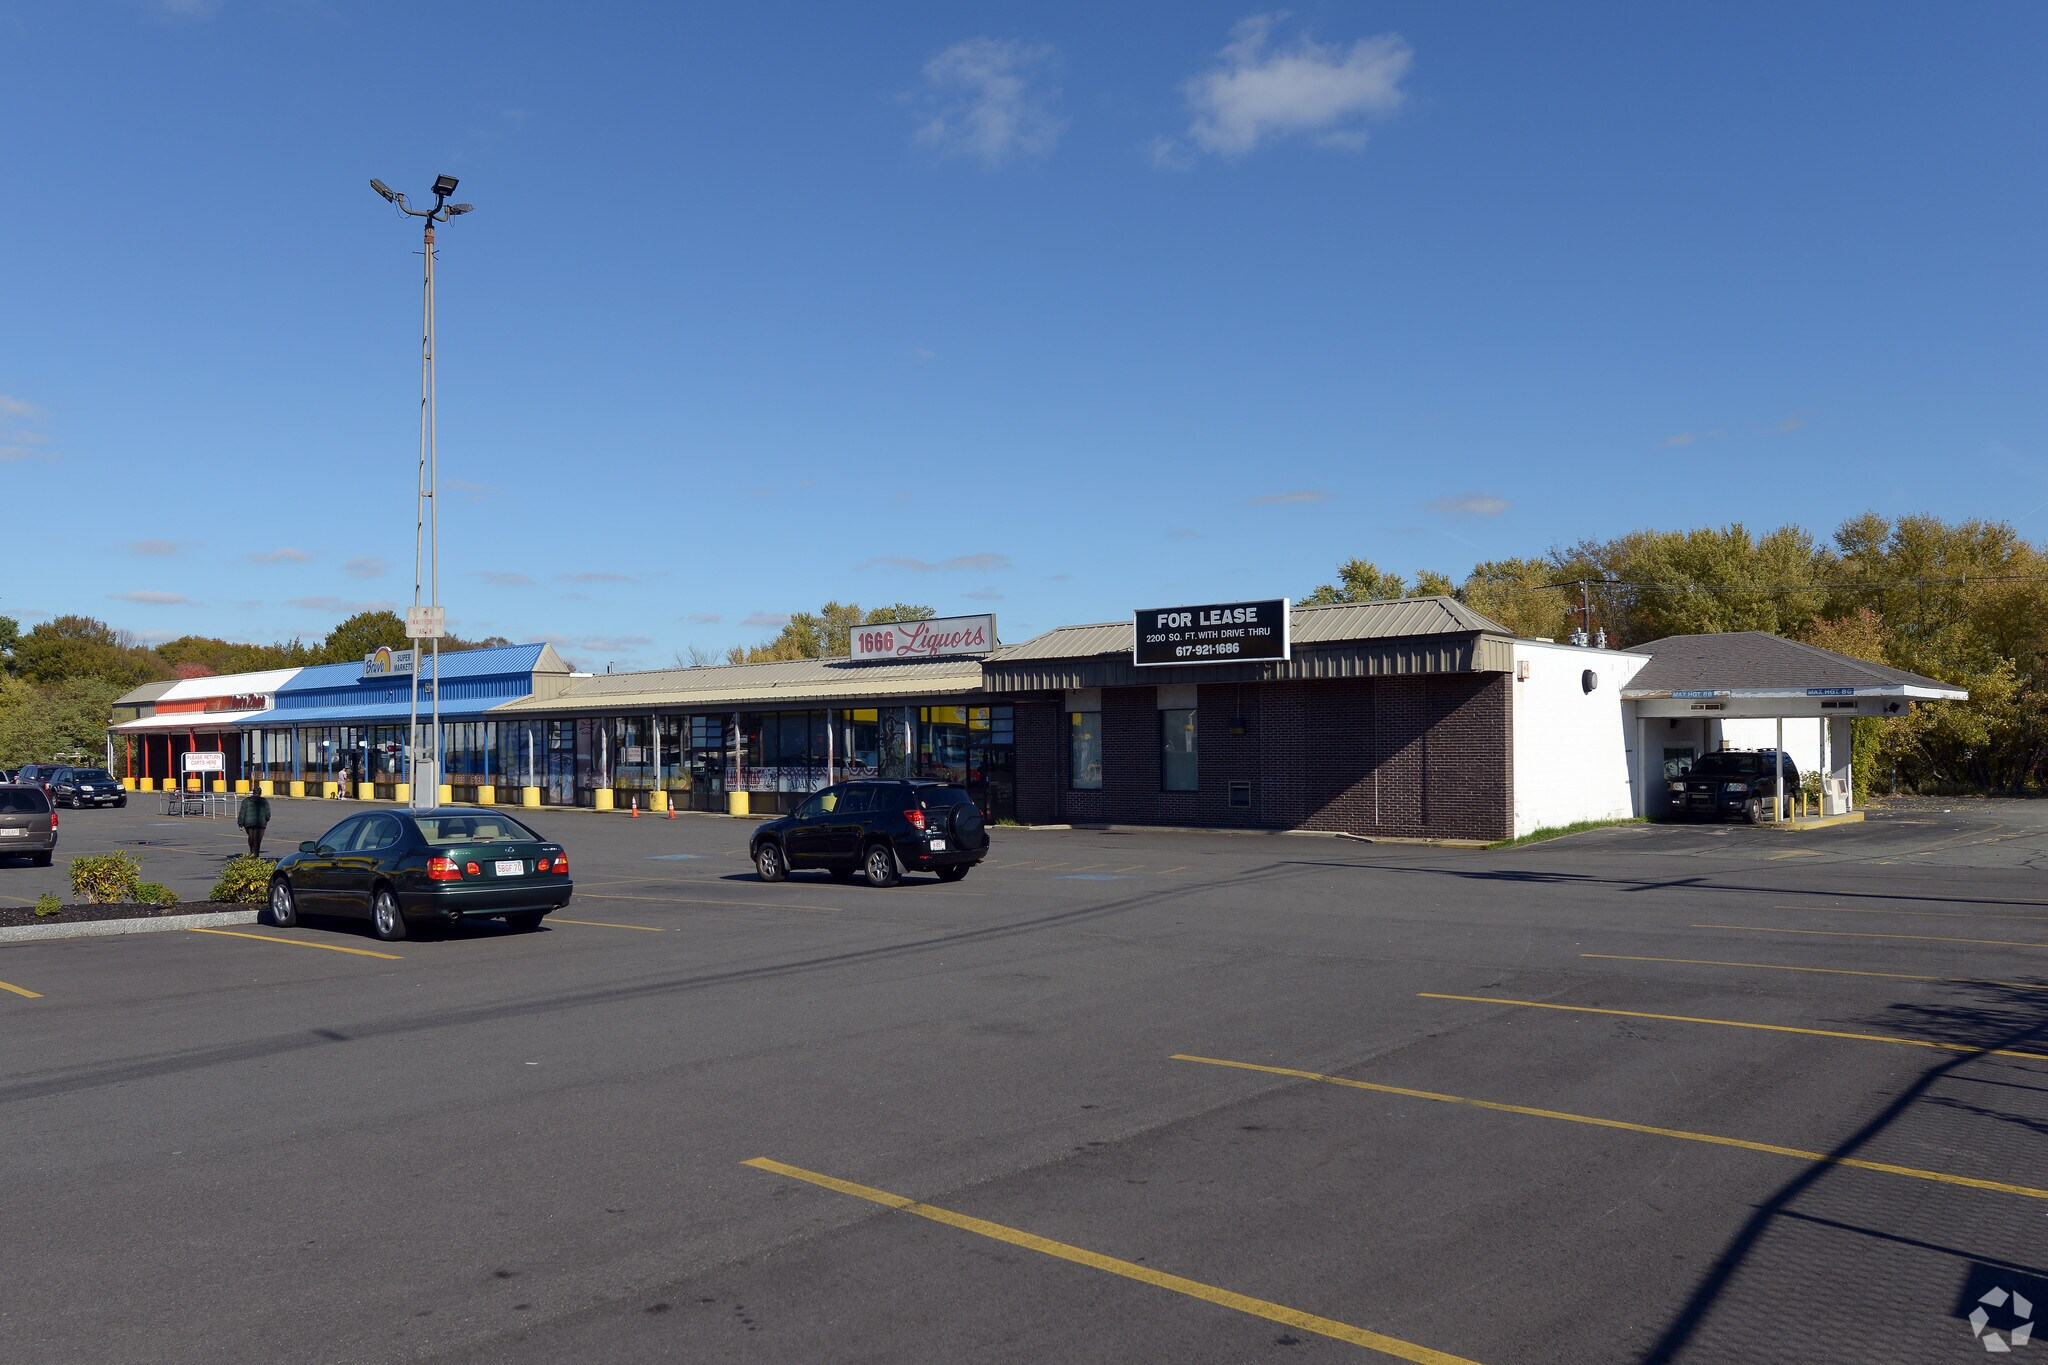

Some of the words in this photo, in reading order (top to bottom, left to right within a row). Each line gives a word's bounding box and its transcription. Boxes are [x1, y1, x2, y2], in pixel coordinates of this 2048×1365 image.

[1157, 612, 1192, 629] FOR
[1200, 607, 1257, 625] LEASE
[858, 630, 894, 654] 1666
[896, 622, 985, 656] Liquors
[1146, 634, 1166, 643] 2200
[1168, 633, 1183, 642] SQ.
[1185, 631, 1198, 640] FT.
[1198, 630, 1218, 640] WITH
[1221, 628, 1245, 638] DRIVE
[1248, 627, 1271, 637] THRU
[1175, 642, 1240, 657] 617-921-1686
[397, 653, 411, 662] SUPER
[394, 662, 413, 671] MARKETS
